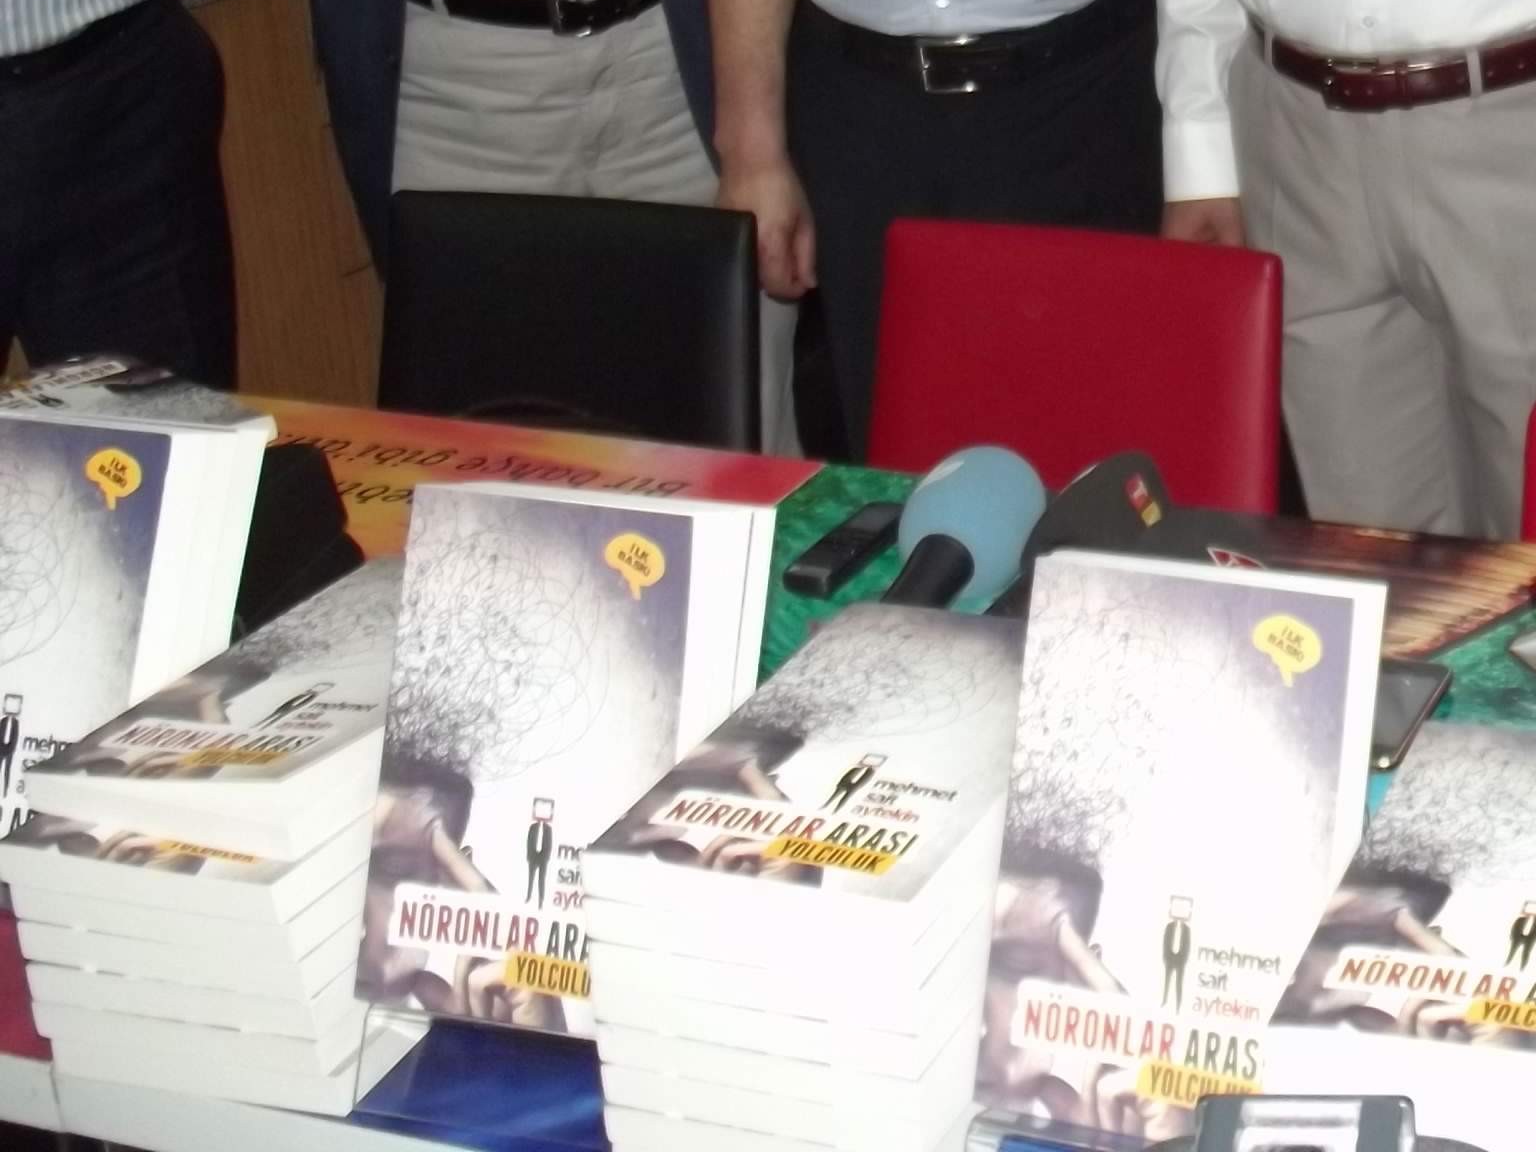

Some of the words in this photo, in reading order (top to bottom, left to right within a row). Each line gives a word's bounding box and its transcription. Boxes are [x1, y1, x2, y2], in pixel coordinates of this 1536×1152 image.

[872, 779, 959, 802] mehmet
[664, 796, 826, 841] NÖRONLAR
[823, 821, 922, 858] ARASI
[776, 839, 888, 874] YOLCULUK
[399, 893, 539, 954] NÖRONLAR
[516, 955, 593, 998] YOLCULU
[1197, 945, 1281, 976] mehmet
[1339, 954, 1517, 1002] NÖRONLAR
[1196, 970, 1230, 992] sait
[1191, 995, 1261, 1026] aytekin
[1023, 993, 1176, 1063] NÖRONLAR
[1184, 1028, 1260, 1081] ARAS
